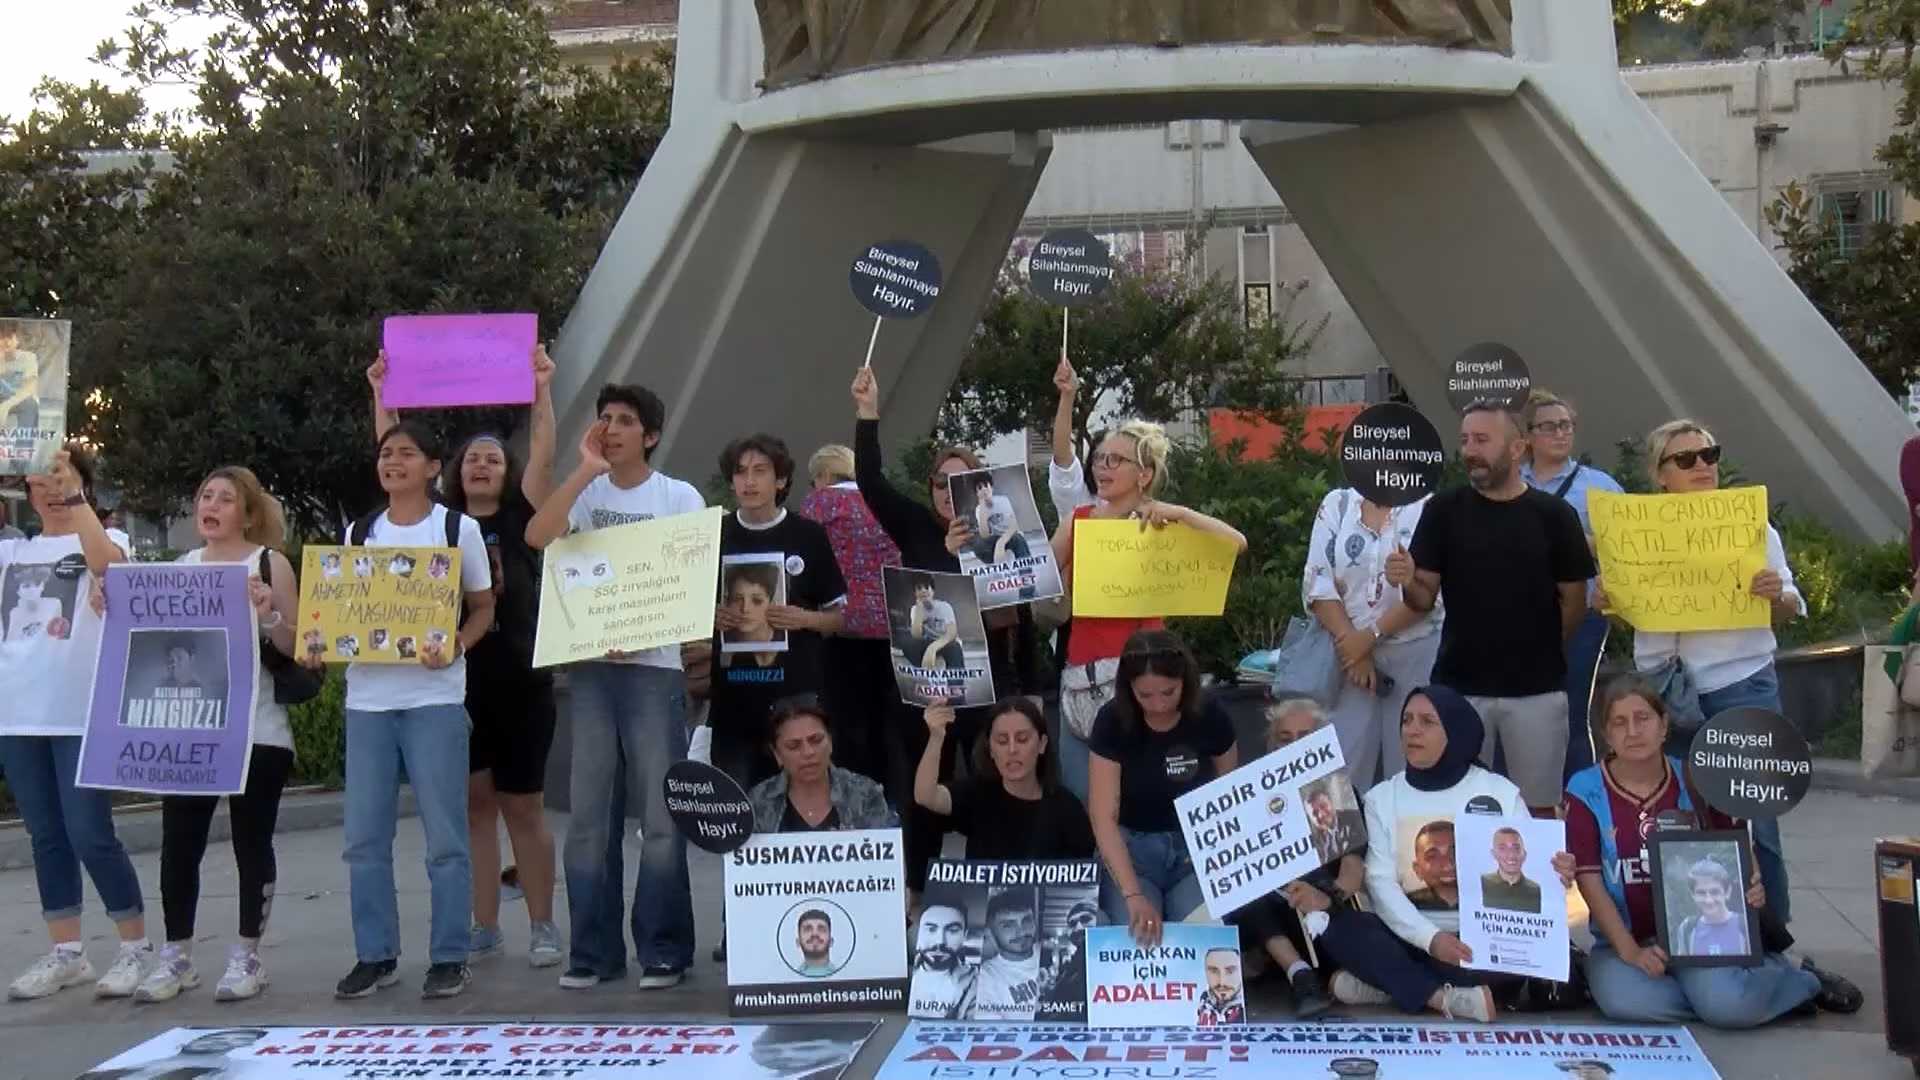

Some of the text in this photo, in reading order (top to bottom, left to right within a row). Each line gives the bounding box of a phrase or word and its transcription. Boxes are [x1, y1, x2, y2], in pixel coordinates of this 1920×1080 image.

[868, 246, 920, 271] Bireysel
[1040, 243, 1086, 258] Bireysel
[1031, 259, 1108, 278] Silahlanmaya
[854, 260, 939, 297] Silahlanmaya
[1053, 277, 1093, 297] Hayır.
[872, 283, 915, 311] Hayır.
[1455, 359, 1503, 374] Bireysel
[1448, 376, 1529, 392] Silahlanmaya
[1352, 425, 1411, 442] Bireysel
[1344, 447, 1443, 464] Silahlanmaya
[1375, 469, 1427, 490] Hayır.
[969, 555, 1048, 577] MATTIA AHMET
[989, 575, 1037, 593] ADALET
[898, 665, 984, 679] MATTIA AHMET
[916, 686, 968, 697] ADALET
[1705, 729, 1773, 749] Bireysel
[119, 740, 221, 765] ADALET
[1694, 751, 1811, 777] Silahlanmaya
[667, 778, 715, 796] Bireysel
[1187, 743, 1335, 828] KADİR ÖZKÖK
[1729, 778, 1788, 803] Hayır.
[667, 797, 750, 814] Silahlanmaya
[697, 820, 743, 839] Hayır.
[1194, 815, 1241, 852] İÇİN
[732, 838, 894, 866] SUSMAYACAĞIZ
[1204, 821, 1284, 876] ADALET
[928, 861, 1097, 885] ADALET İSTİYORUZ!
[733, 875, 896, 898] UNUTTURMAYACAĞIZ!
[1474, 911, 1554, 929] BATUHAN KURT
[1482, 920, 1547, 939] İÇİN ADALET
[1099, 947, 1197, 963] BURAK KAN
[1133, 962, 1168, 981] İÇİN
[735, 986, 902, 1007] #muhammetinsesiolun
[1092, 982, 1199, 1004] ADALET
[915, 1000, 955, 1012] BURAK
[1041, 1000, 1085, 1013] SAMET
[299, 1027, 736, 1040] ADALET SUSTUKÇA
[1416, 1027, 1681, 1049] İSTEMİYORUZ!
[903, 1044, 1250, 1062] ADALET!
